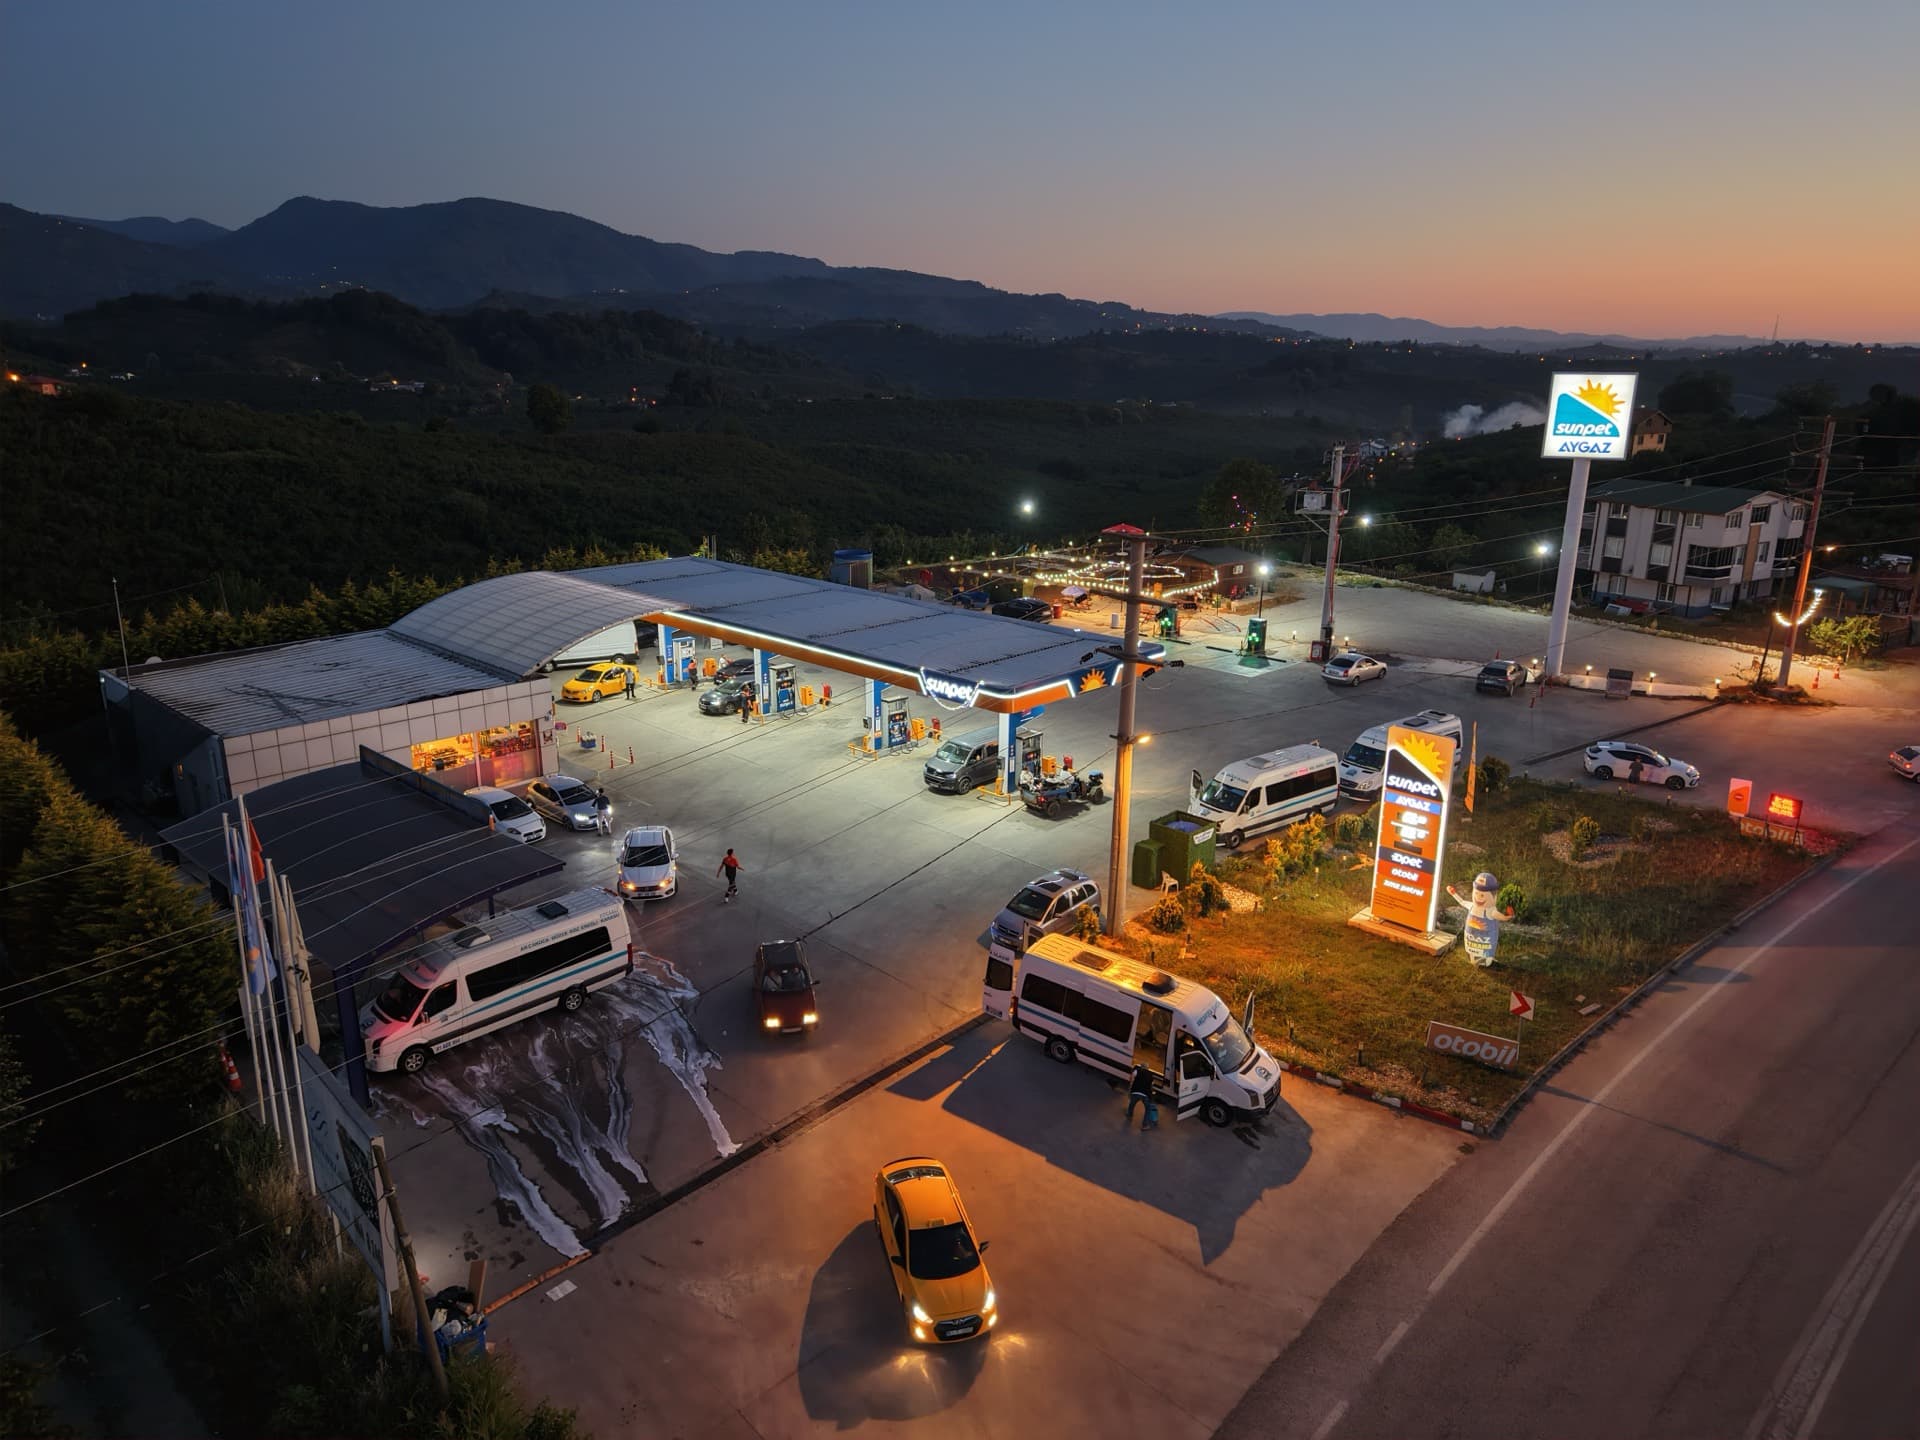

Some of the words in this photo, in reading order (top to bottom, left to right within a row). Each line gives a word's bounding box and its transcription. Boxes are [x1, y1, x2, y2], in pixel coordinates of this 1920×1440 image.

[1555, 423, 1613, 436] sunpet
[1558, 441, 1612, 453] AYGAZ
[926, 677, 973, 701] sunpet
[1387, 775, 1438, 797] sunpet
[1391, 868, 1419, 882] otobil
[1433, 1034, 1517, 1065] otobil
